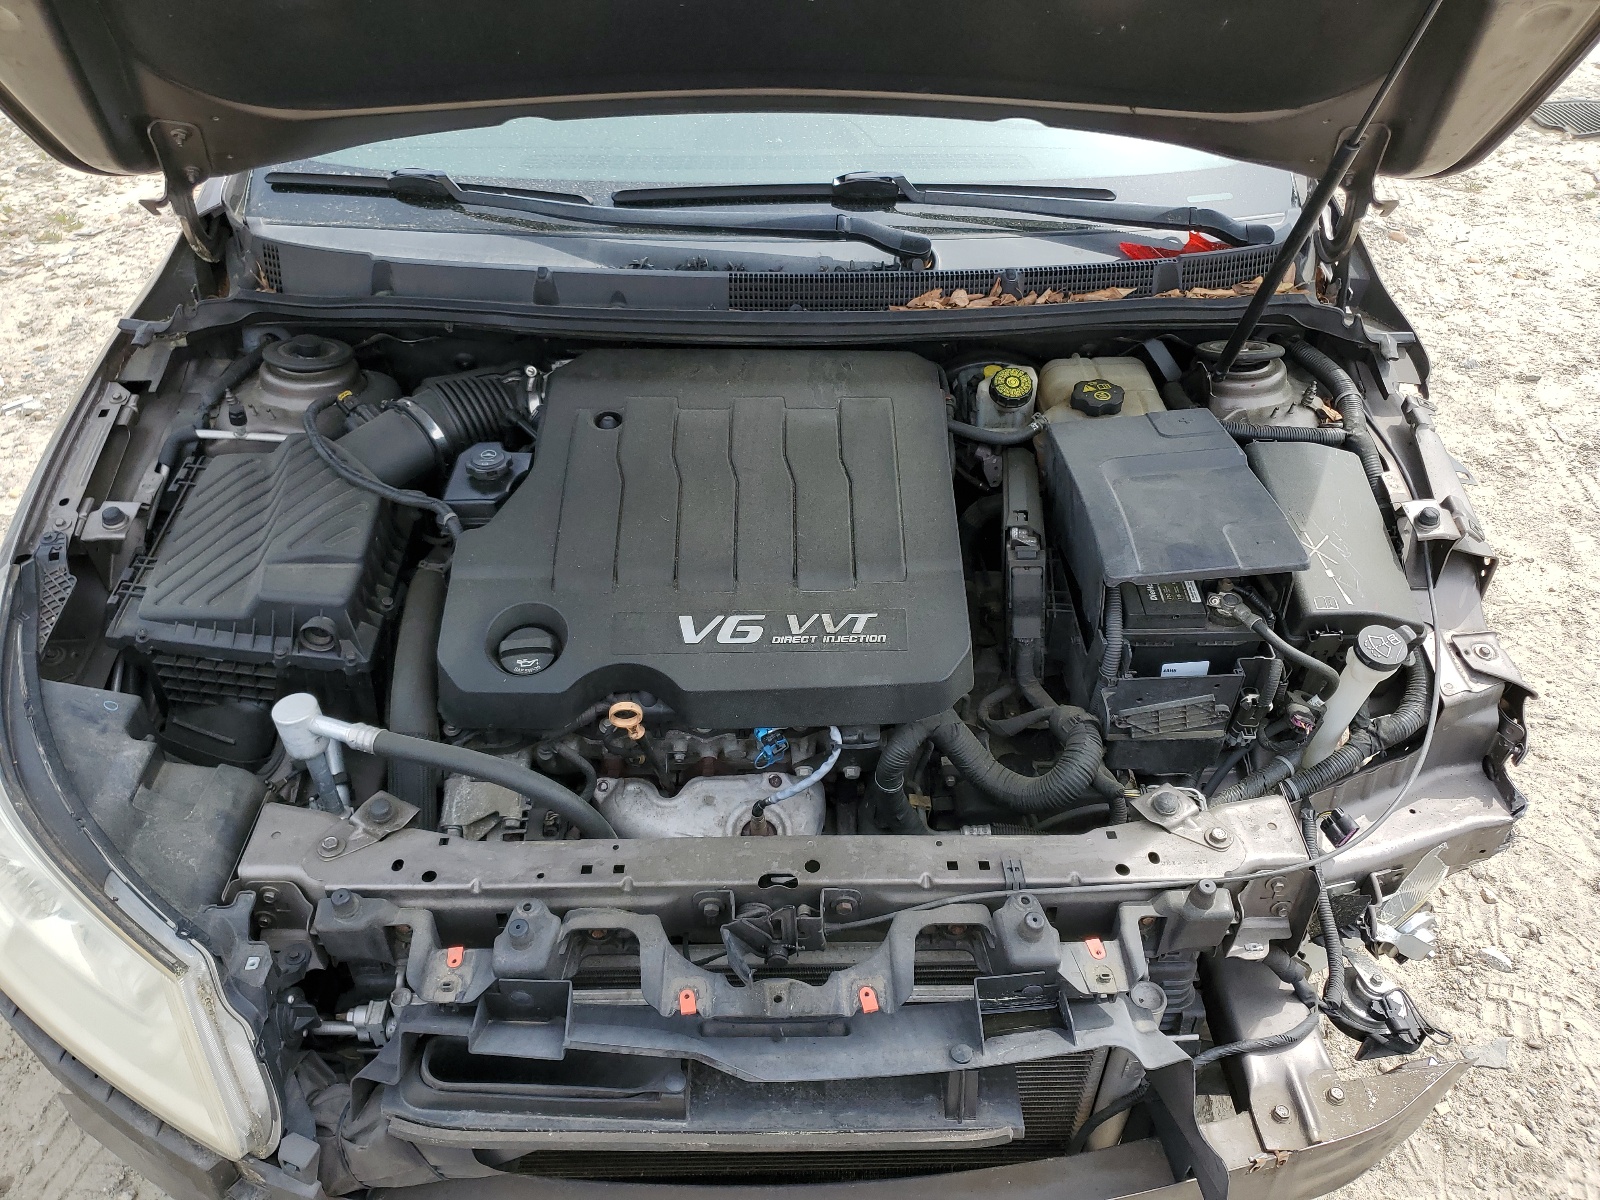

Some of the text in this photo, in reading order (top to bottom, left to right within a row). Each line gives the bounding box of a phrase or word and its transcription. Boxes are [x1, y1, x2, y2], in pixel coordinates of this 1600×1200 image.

[678, 613, 879, 644] V6 VVT
[772, 634, 887, 644] DIRECT INJECTION
